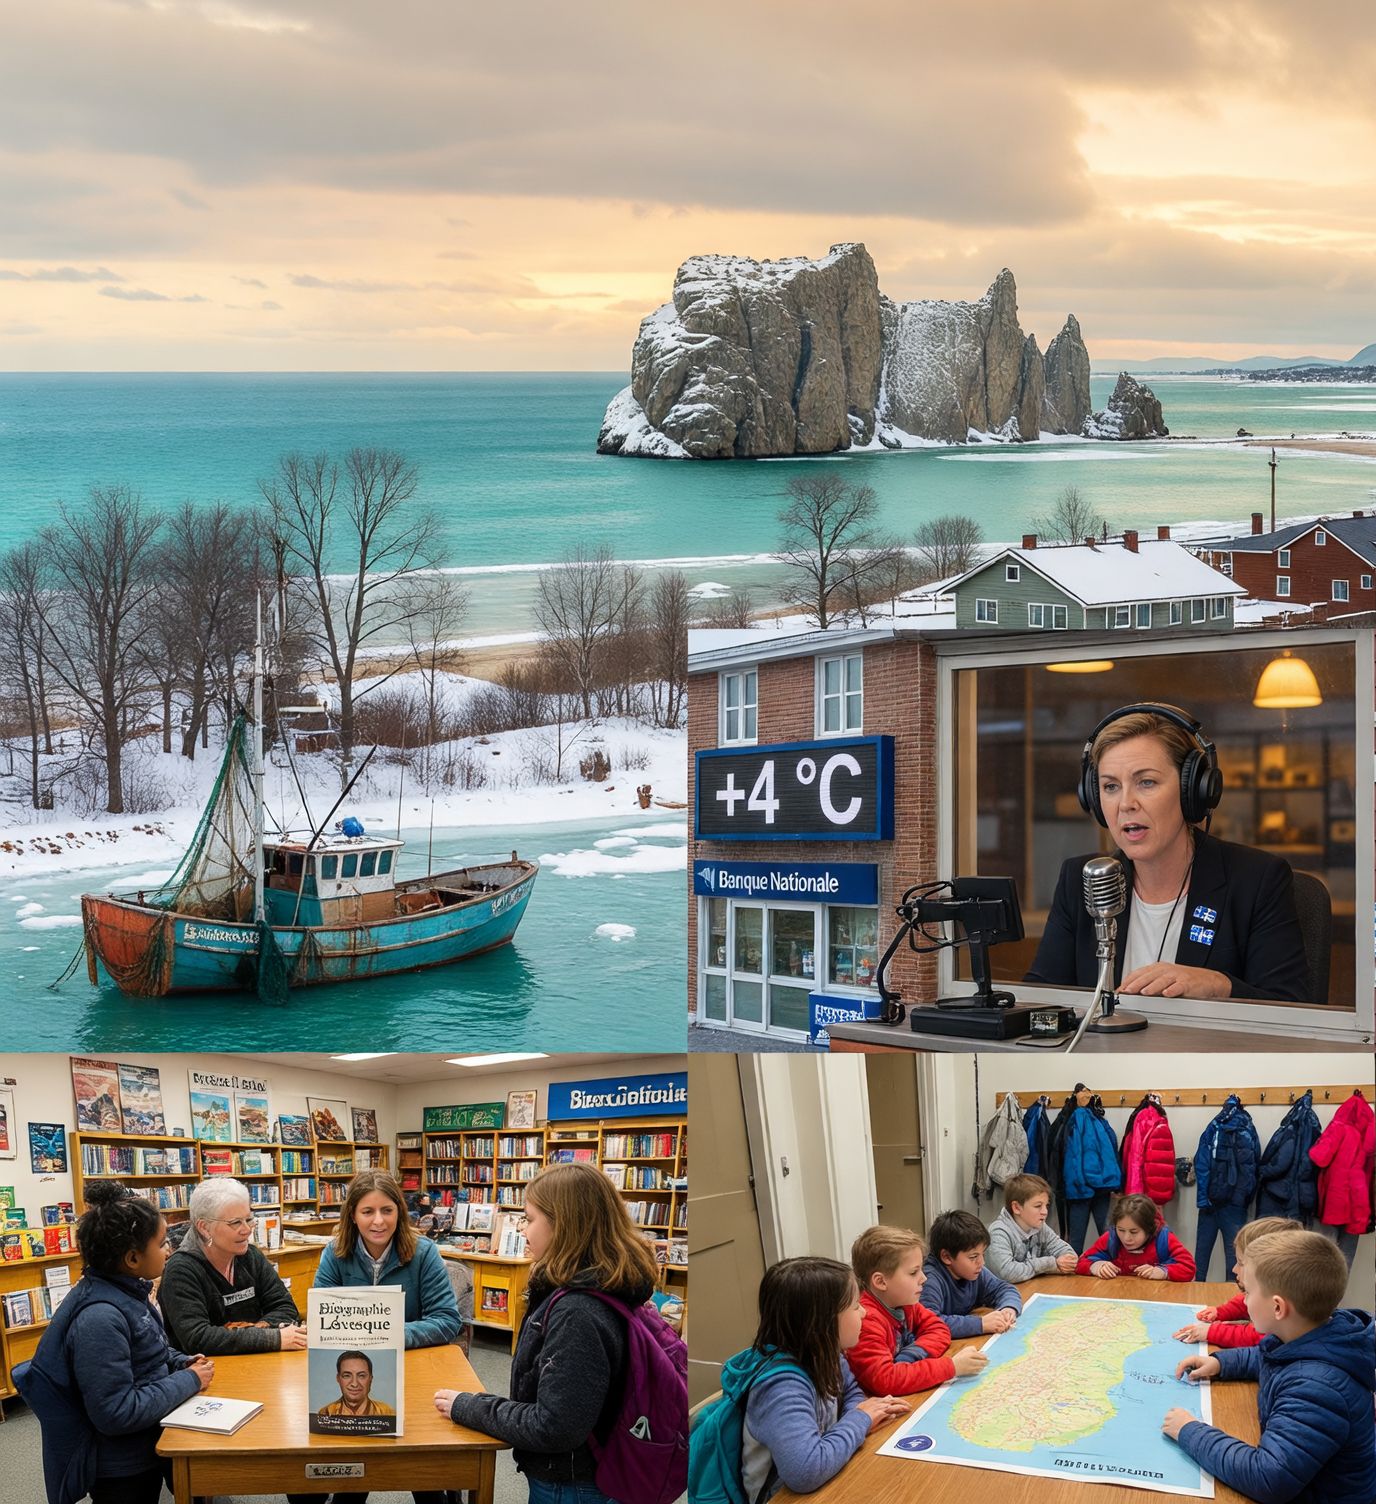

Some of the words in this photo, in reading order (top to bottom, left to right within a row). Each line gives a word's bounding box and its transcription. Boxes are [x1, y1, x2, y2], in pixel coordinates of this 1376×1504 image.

[716, 760, 780, 824] +4
[719, 870, 768, 895] Banque
[770, 871, 839, 893] Nationale
